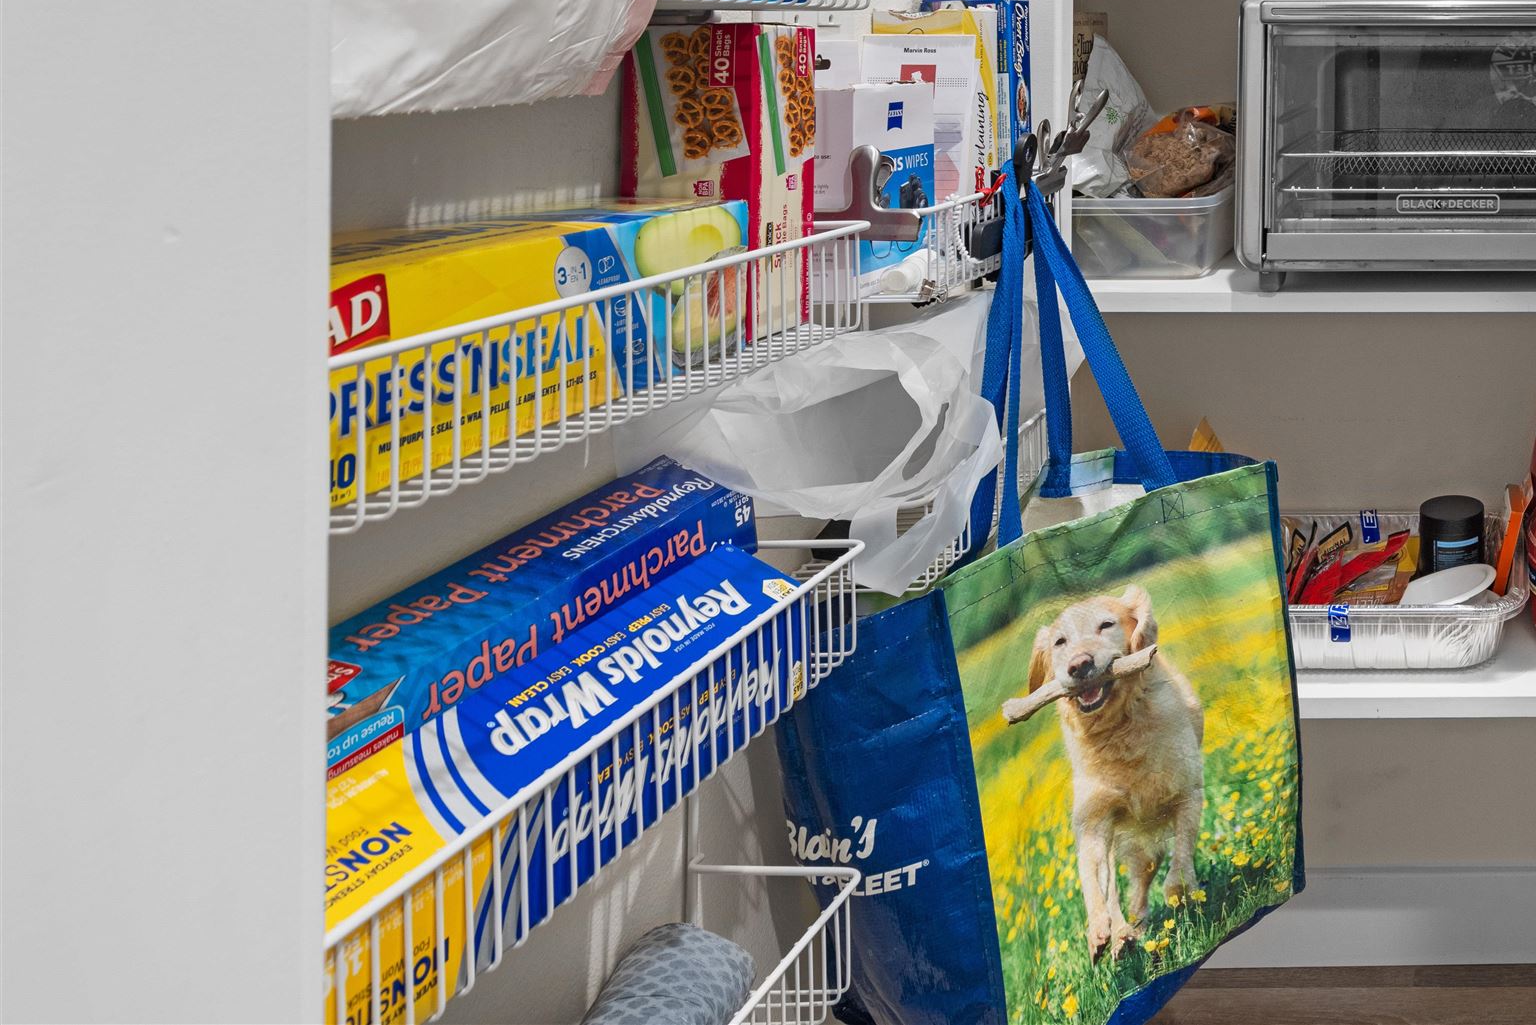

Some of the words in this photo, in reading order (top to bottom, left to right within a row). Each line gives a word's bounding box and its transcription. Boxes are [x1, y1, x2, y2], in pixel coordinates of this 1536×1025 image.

[1013, 2, 1025, 38] Oven
[715, 29, 724, 57] Snack
[723, 33, 731, 57] Bags
[903, 47, 922, 55] Marvin
[712, 57, 731, 86] 40
[799, 54, 808, 75] 40
[1013, 39, 1025, 80] Bags
[904, 153, 929, 170] WIPES
[701, 181, 710, 196] BPA
[1401, 197, 1495, 211] BLACK+DECKER
[734, 505, 751, 528] 45
[468, 480, 666, 585] Parchment
[545, 519, 708, 646] Parchment
[344, 581, 488, 652] Paper
[652, 603, 672, 619] EASY
[598, 576, 752, 688] Reynolds
[605, 630, 627, 646] EASY
[689, 628, 705, 642] MADE
[421, 625, 541, 722] Paper
[547, 663, 573, 681] EASY
[359, 711, 395, 739] Reuse
[489, 670, 618, 757] Wrap
[326, 740, 344, 761] to
[341, 727, 361, 752] up
[373, 730, 400, 755] makes
[326, 745, 374, 780] measuring
[342, 825, 369, 849] Food
[369, 843, 414, 882] EVERYDAY
